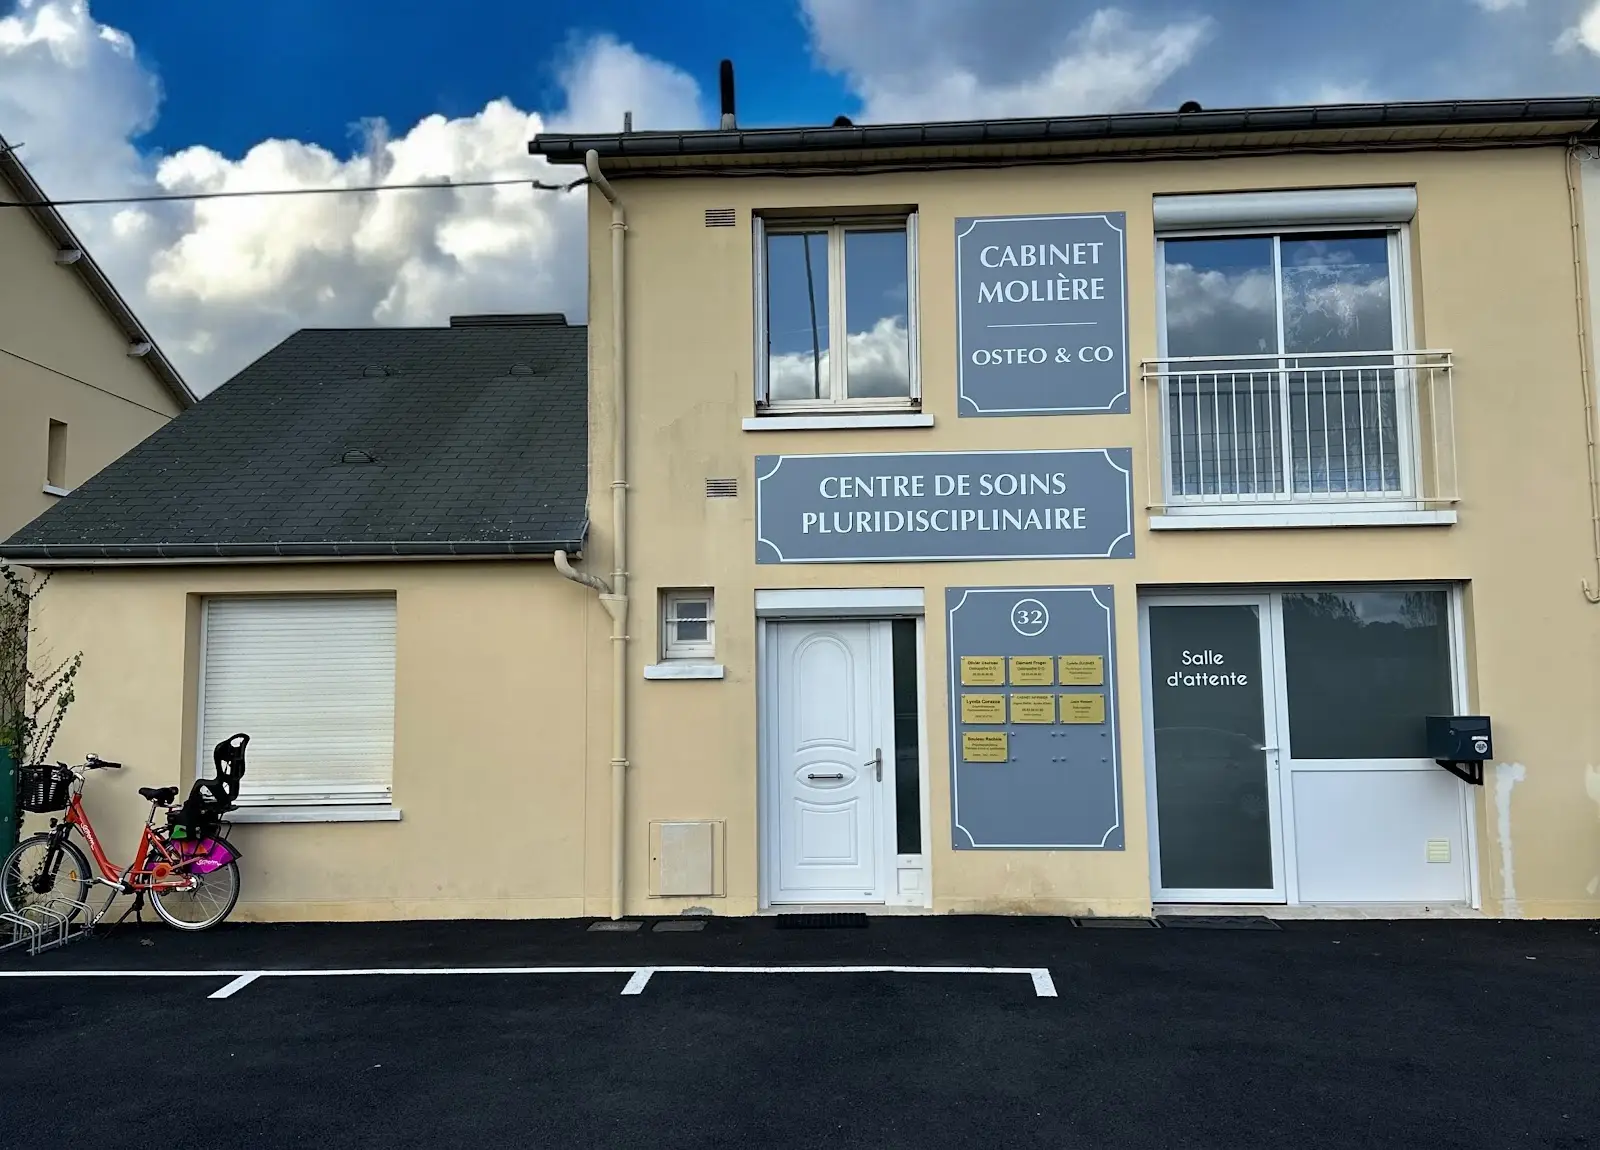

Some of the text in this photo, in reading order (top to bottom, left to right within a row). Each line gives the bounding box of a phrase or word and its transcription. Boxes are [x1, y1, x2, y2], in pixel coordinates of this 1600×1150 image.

[980, 242, 1104, 268] CABINET
[977, 272, 1105, 304] MOLIÈRE
[971, 345, 1114, 366] OSTEO & CO
[819, 472, 1067, 499] CENTRE DE SOINS
[802, 507, 1087, 534] PLURIDISCIPLINAIRE
[1017, 609, 1043, 625] 32
[1181, 649, 1224, 666] Salle
[1166, 671, 1248, 687] d'attente
